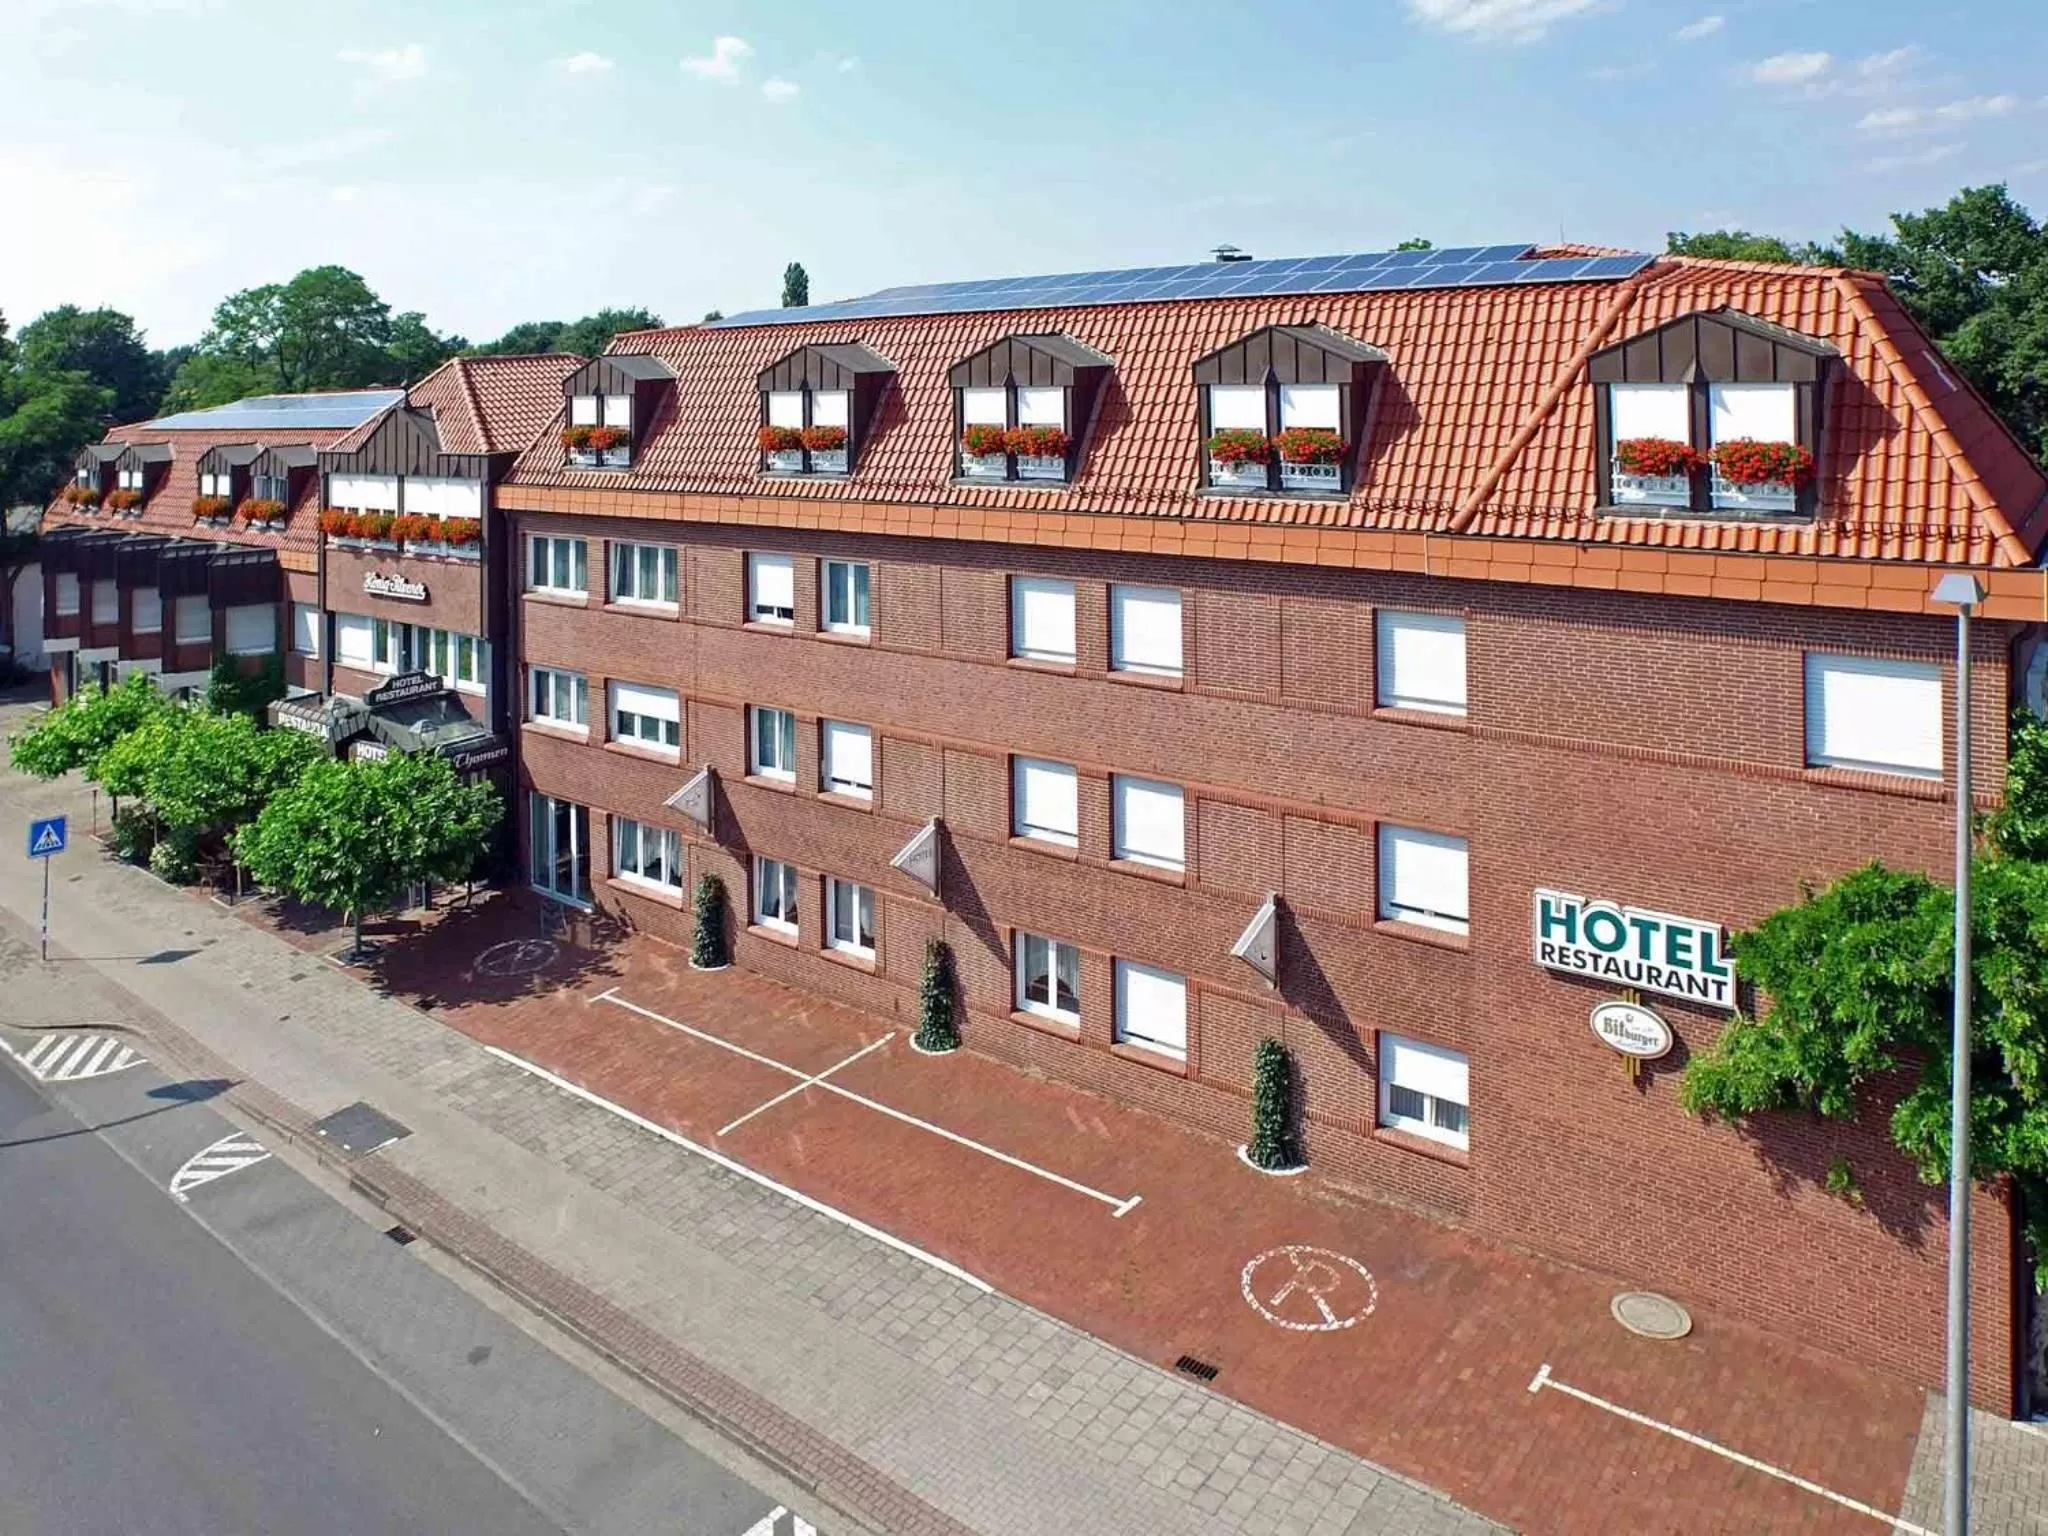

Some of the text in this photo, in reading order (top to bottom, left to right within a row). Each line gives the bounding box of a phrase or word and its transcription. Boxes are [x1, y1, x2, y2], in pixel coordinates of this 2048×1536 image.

[375, 681, 437, 702] RESTAURANT
[392, 675, 423, 688] HOTEL
[1540, 898, 1729, 977] HOTEL
[1540, 942, 1729, 1001] RESTAURANT
[1603, 1016, 1659, 1047] Bitburger
